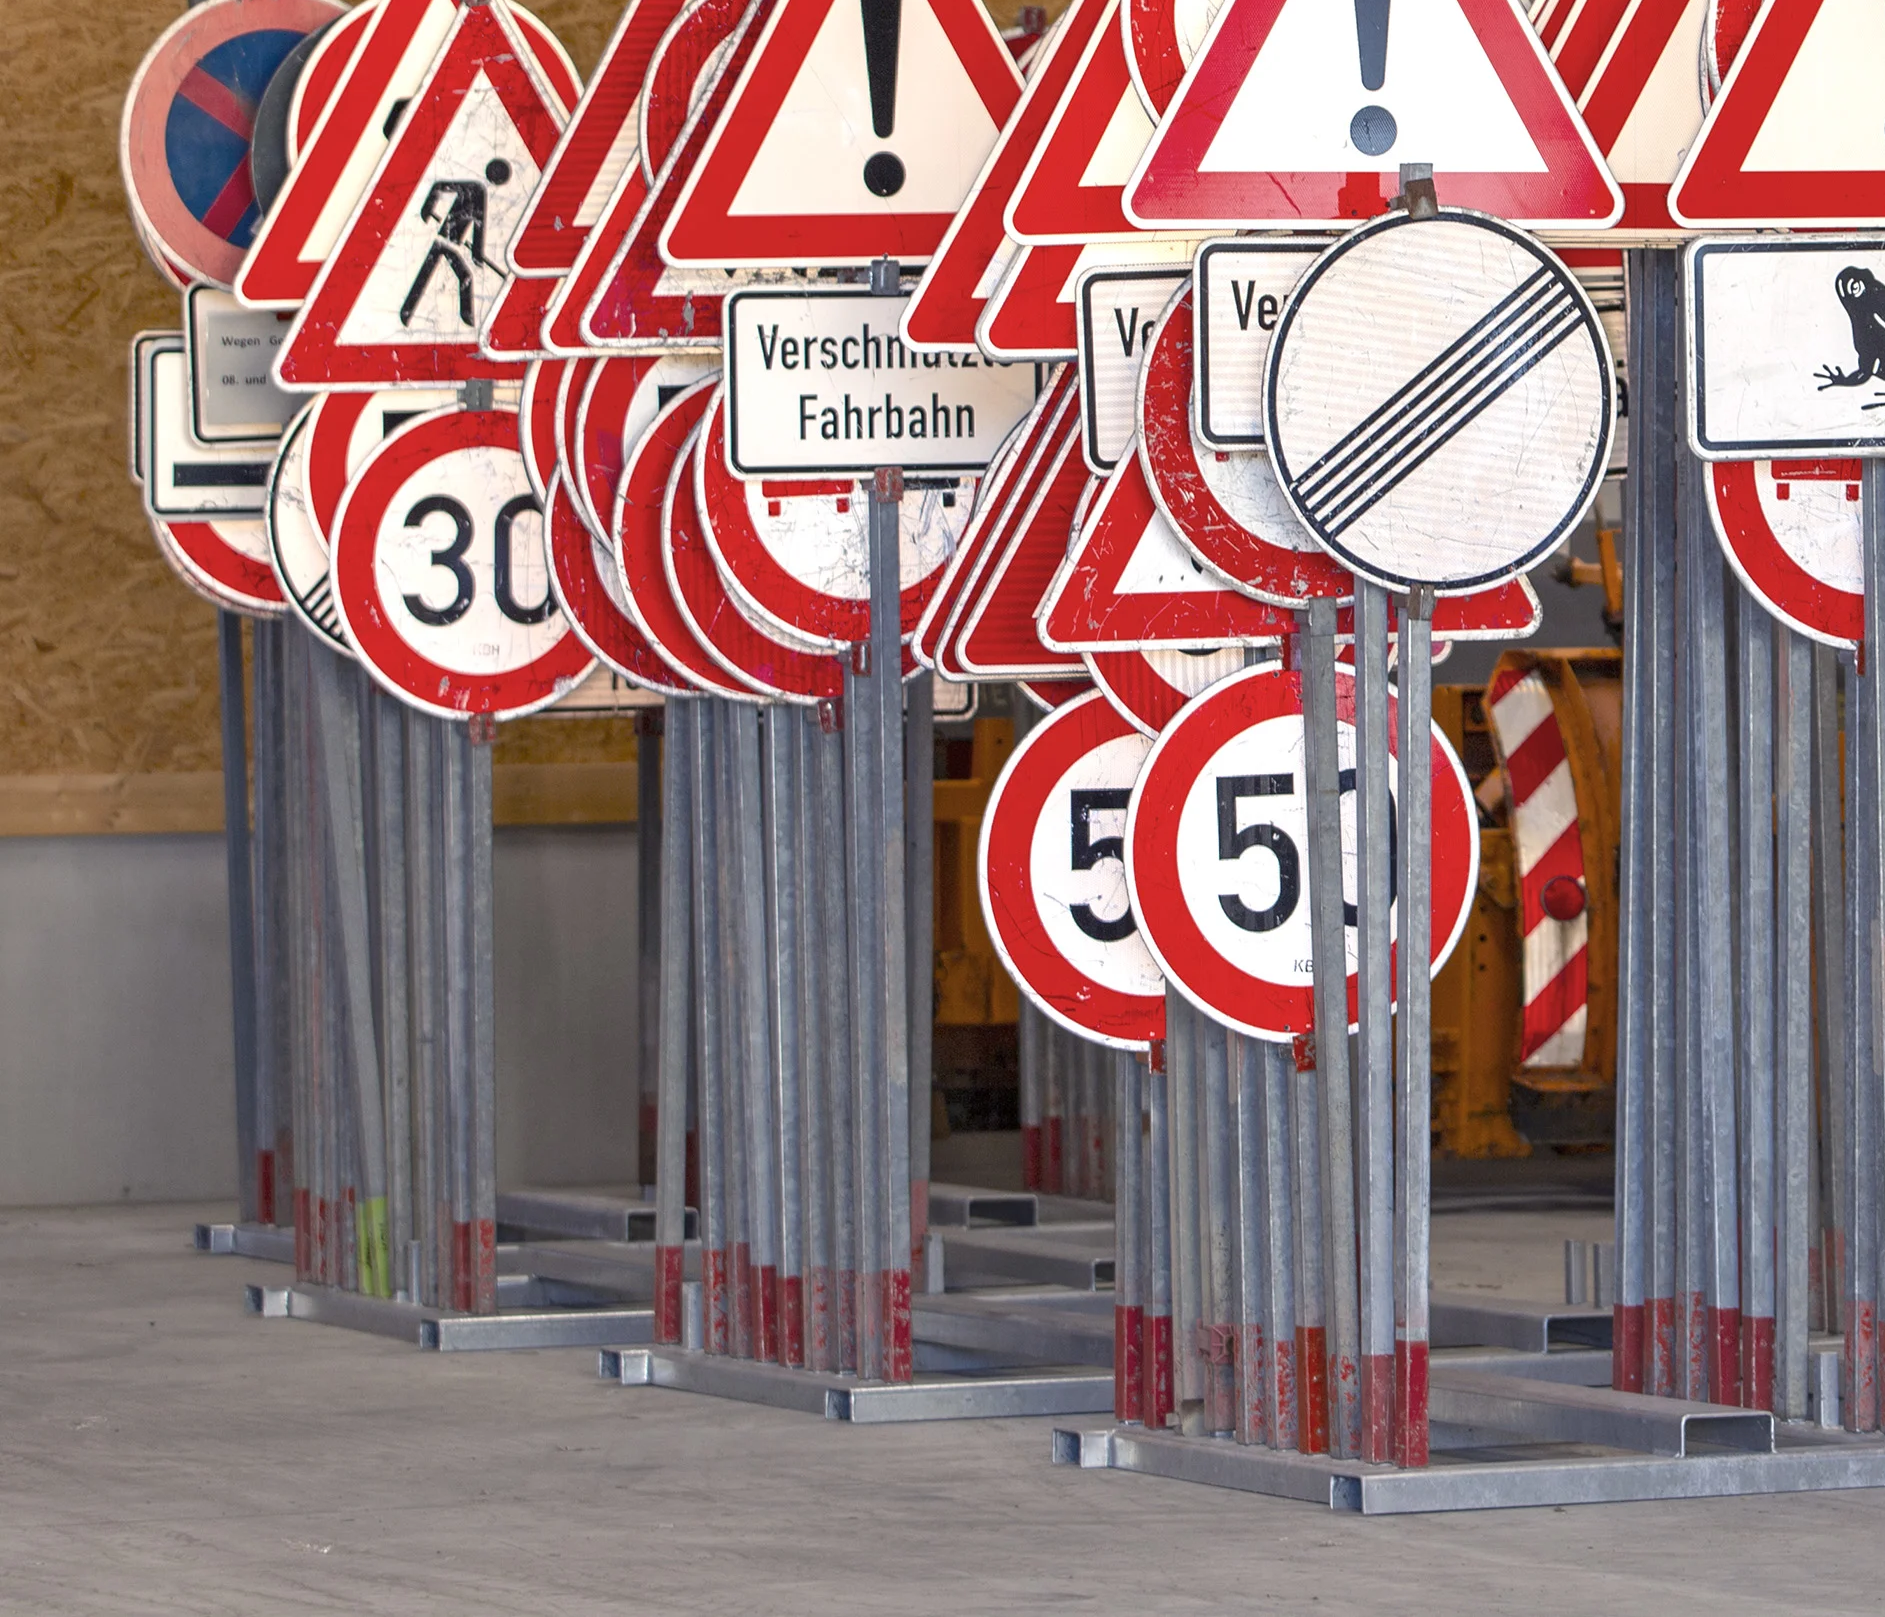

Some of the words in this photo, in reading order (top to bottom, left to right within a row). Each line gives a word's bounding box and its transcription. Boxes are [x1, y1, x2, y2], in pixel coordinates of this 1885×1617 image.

[1231, 280, 1289, 331] Ve
[221, 335, 261, 349] Wegen
[757, 323, 1013, 370] Verschm
[245, 373, 267, 386] und
[799, 392, 975, 440] Fahrbahn
[402, 493, 560, 626] 30
